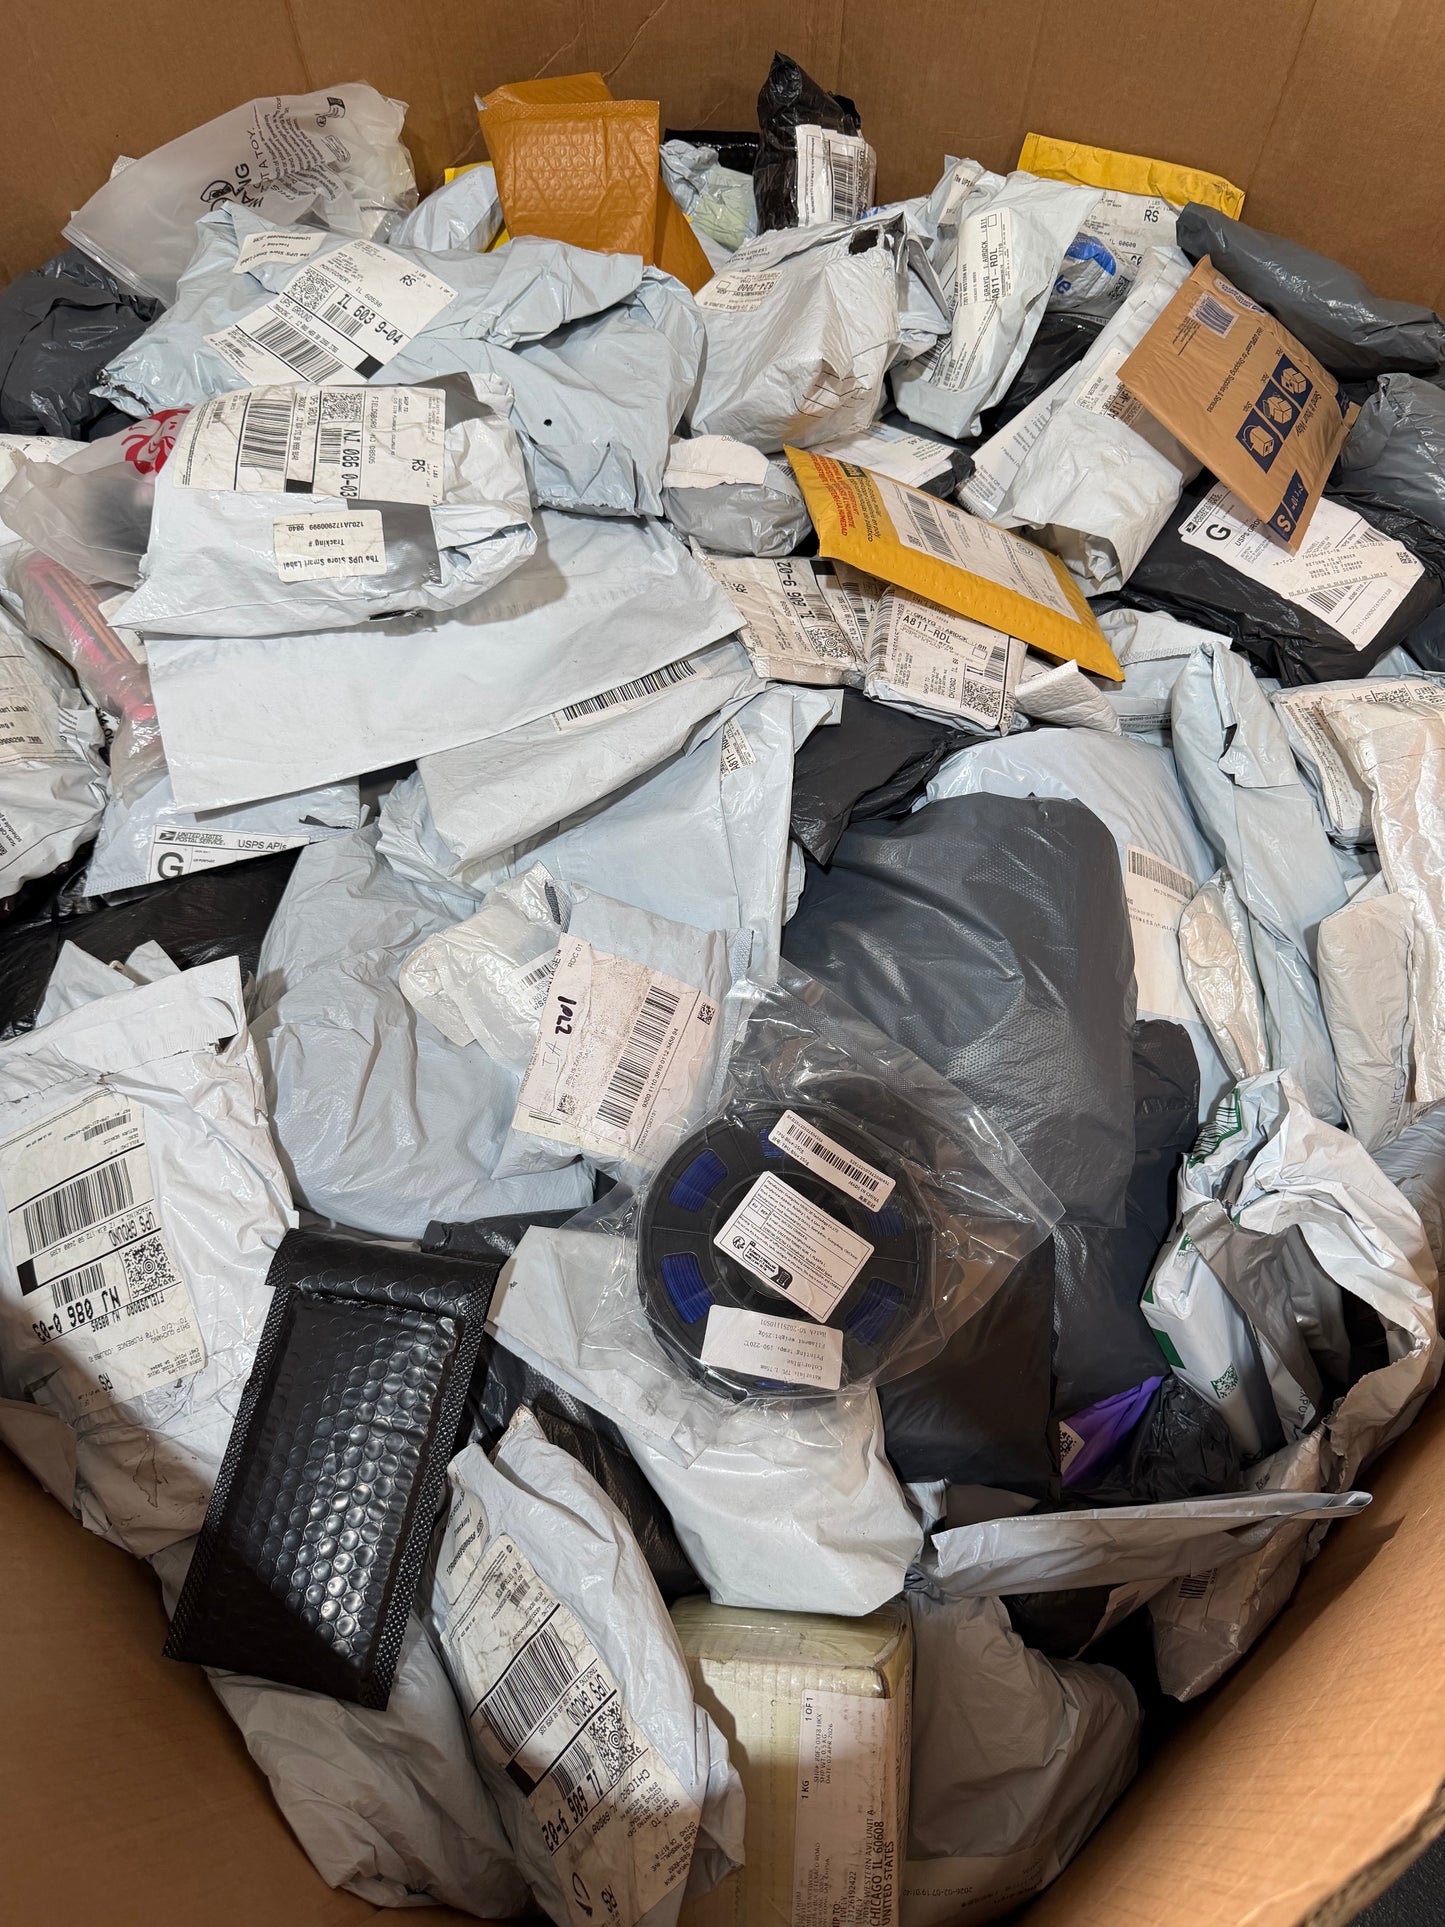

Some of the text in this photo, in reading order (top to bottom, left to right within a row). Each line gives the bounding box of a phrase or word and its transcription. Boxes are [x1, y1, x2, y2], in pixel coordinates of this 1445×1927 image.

[257, 158, 269, 170] A
[1143, 208, 1159, 223] RS
[319, 263, 351, 285] MONTGOMERY
[399, 274, 417, 287] RS
[279, 296, 313, 323] UPS GROUND
[336, 293, 404, 345] IL 603 9-04
[1229, 357, 1245, 376] Shipping
[1219, 374, 1235, 392] Supplies
[1206, 394, 1222, 413] Services
[367, 396, 378, 464] FIELDSBORO 08505
[338, 430, 360, 498] NJ 086 0-03
[1002, 448, 1015, 463] Patches
[411, 458, 424, 472] RS
[987, 473, 995, 481] the
[1191, 491, 1217, 523] UNITED STATES
[1195, 509, 1210, 526] POSTAL
[1272, 512, 1295, 533] S
[1205, 523, 1232, 541] G
[1234, 531, 1250, 547] USPS
[313, 536, 343, 547] Tracking
[282, 560, 302, 569] Label
[303, 557, 324, 566] Smart
[347, 555, 363, 564] UPS
[365, 554, 378, 563] The
[1305, 559, 1325, 568] RETURN
[1336, 553, 1356, 562] SENDER
[776, 561, 797, 587] 9-02
[1308, 566, 1328, 576] UNABLE
[1340, 560, 1363, 570] FORWARD
[1310, 570, 1331, 579] RETURN
[1342, 563, 1363, 573] SENDER
[732, 582, 747, 593] RS
[786, 591, 806, 608] 606
[799, 610, 814, 619] IL
[902, 614, 950, 644] A811-RDL
[13, 704, 30, 714] Label
[237, 838, 264, 849] USPS
[157, 851, 184, 881] G
[567, 943, 583, 968] RDC 01
[641, 1050, 670, 1108] 9300 1110 0112
[847, 1180, 861, 1191] MADE
[865, 1192, 880, 1203] CHINA
[125, 1205, 152, 1220] TRACKING
[108, 1210, 157, 1247] UPS GROUND
[123, 1290, 164, 1316] FIELDSBORO
[30, 1285, 121, 1343] NJ 086 0-03
[108, 1309, 121, 1323] NJ
[175, 1321, 190, 1333] SHIP
[116, 1321, 172, 1351] C/O FLORENCE
[173, 1352, 187, 1362] POINT
[794, 1348, 824, 1361] Printing
[146, 1367, 160, 1379] DRIVE
[578, 1666, 598, 1686] TRACKING
[563, 1673, 611, 1726] UPS GROUND
[805, 1702, 813, 1714] OF
[821, 1733, 827, 1743] KG
[826, 1755, 832, 1763] 07
[824, 1765, 832, 1784] DATE:
[801, 1779, 810, 1792] KG
[541, 1768, 604, 1851] IL 606 9-02
[661, 1799, 680, 1818] SHIP
[678, 1820, 696, 1837] CHINO
[863, 1817, 875, 1838] UNIT
[658, 1841, 683, 1861] MARSHALL
[860, 1857, 875, 1898] WESTERN
[865, 1819, 887, 1927] CHICAGO IL 60608
[878, 1839, 898, 1927] UNITED STATES
[600, 1885, 618, 1913] RS
